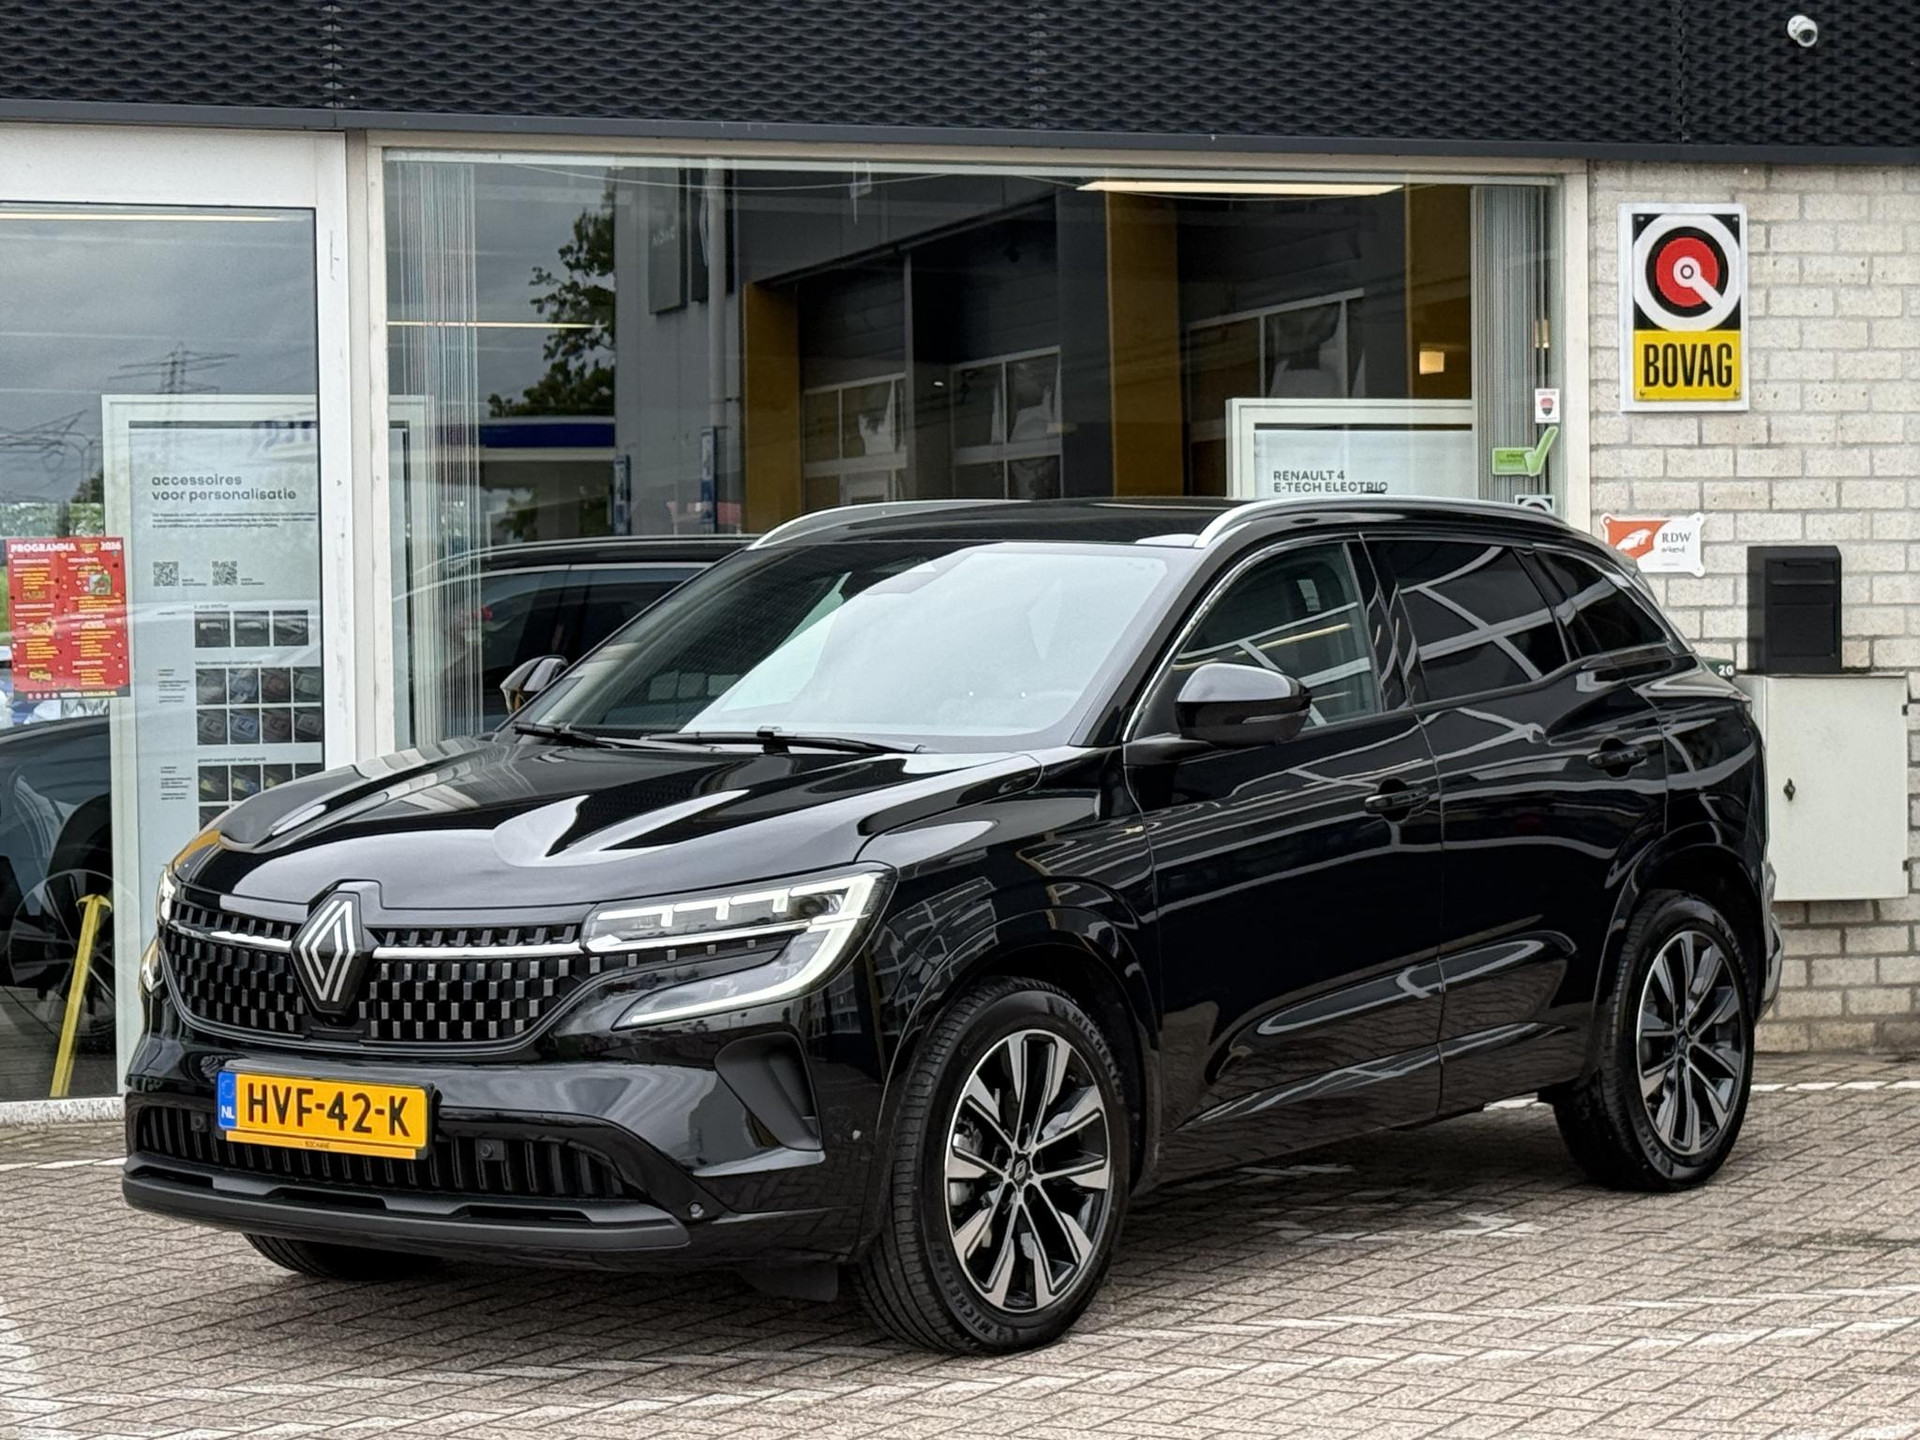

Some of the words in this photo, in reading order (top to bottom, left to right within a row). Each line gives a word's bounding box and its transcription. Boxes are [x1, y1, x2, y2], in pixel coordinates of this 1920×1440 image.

[1643, 342, 1733, 388] BOVAG
[152, 474, 242, 486] accessoires
[1273, 470, 1335, 480] RENAULT
[1337, 470, 1345, 480] 4
[1273, 482, 1321, 493] E-TECH
[152, 490, 186, 501] voor
[189, 488, 297, 503] personalisatie
[1661, 532, 1692, 543] RDW
[11, 542, 77, 553] PROGRAMMA
[1718, 664, 1734, 676] 20
[220, 1105, 236, 1120] NL
[247, 1082, 411, 1138] HVF-42-K
